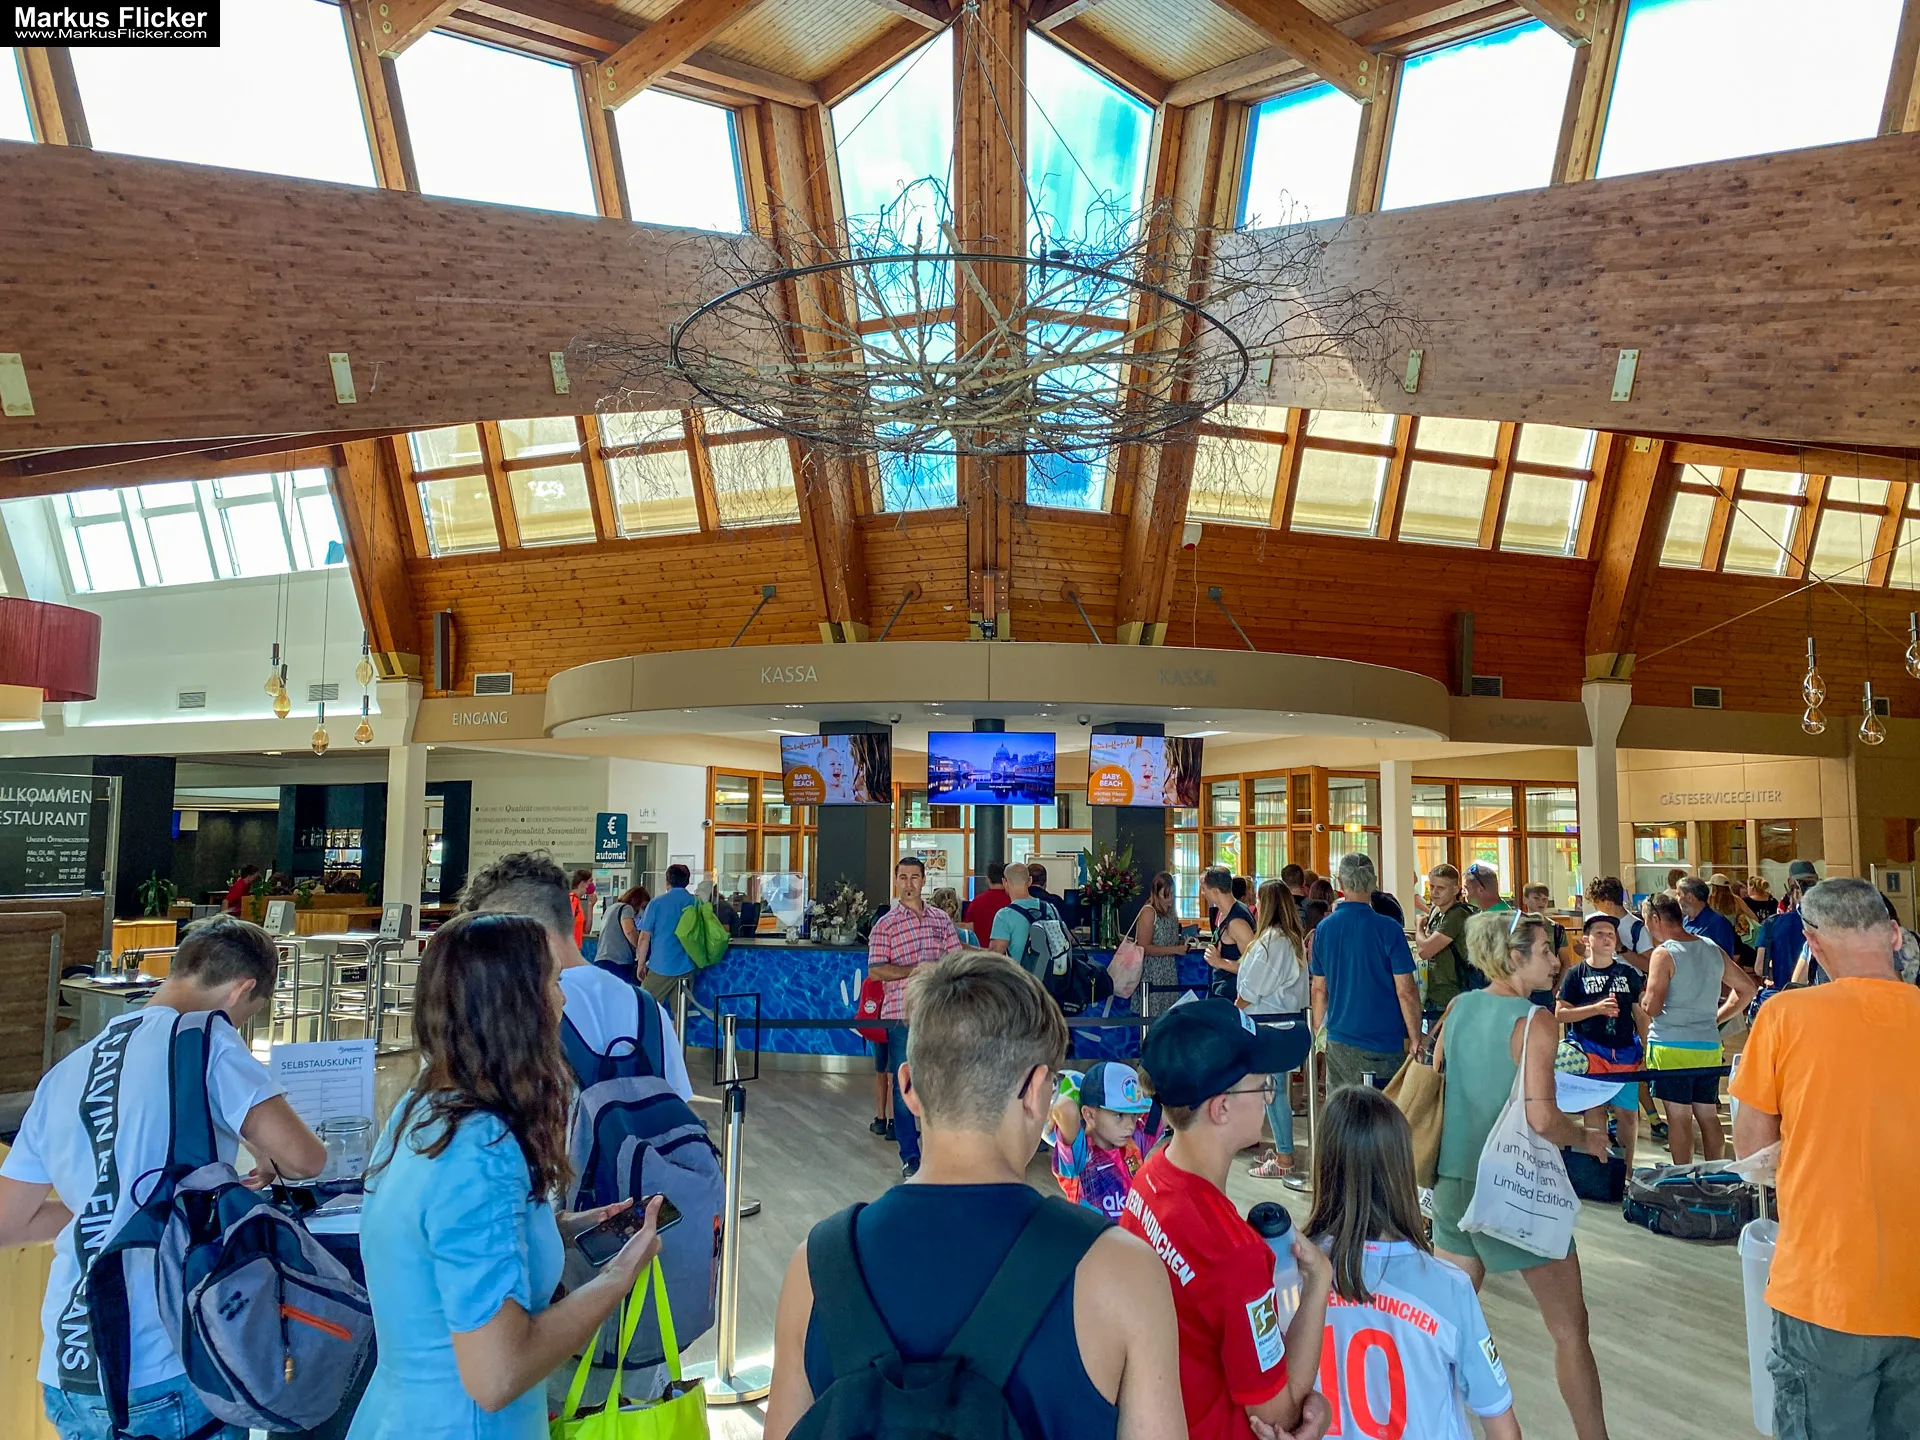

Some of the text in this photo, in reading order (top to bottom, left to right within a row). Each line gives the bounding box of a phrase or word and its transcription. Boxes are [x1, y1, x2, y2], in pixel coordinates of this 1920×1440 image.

[761, 665, 818, 684] KASSA
[452, 711, 509, 726] EINGANG
[1660, 790, 1782, 806] GÄSTESERVICECENTER
[505, 805, 533, 813] Qualität
[602, 838, 621, 849] Zahl-
[595, 850, 627, 860] automat
[281, 1056, 363, 1070] SELBSTAUSKUNFT
[1496, 1141, 1501, 1152] I
[1503, 1144, 1520, 1156] am
[1515, 1162, 1534, 1182] But
[1540, 1175, 1557, 1188] am
[1493, 1174, 1575, 1211] Limited Edition.
[1319, 1323, 1408, 1440] 10
